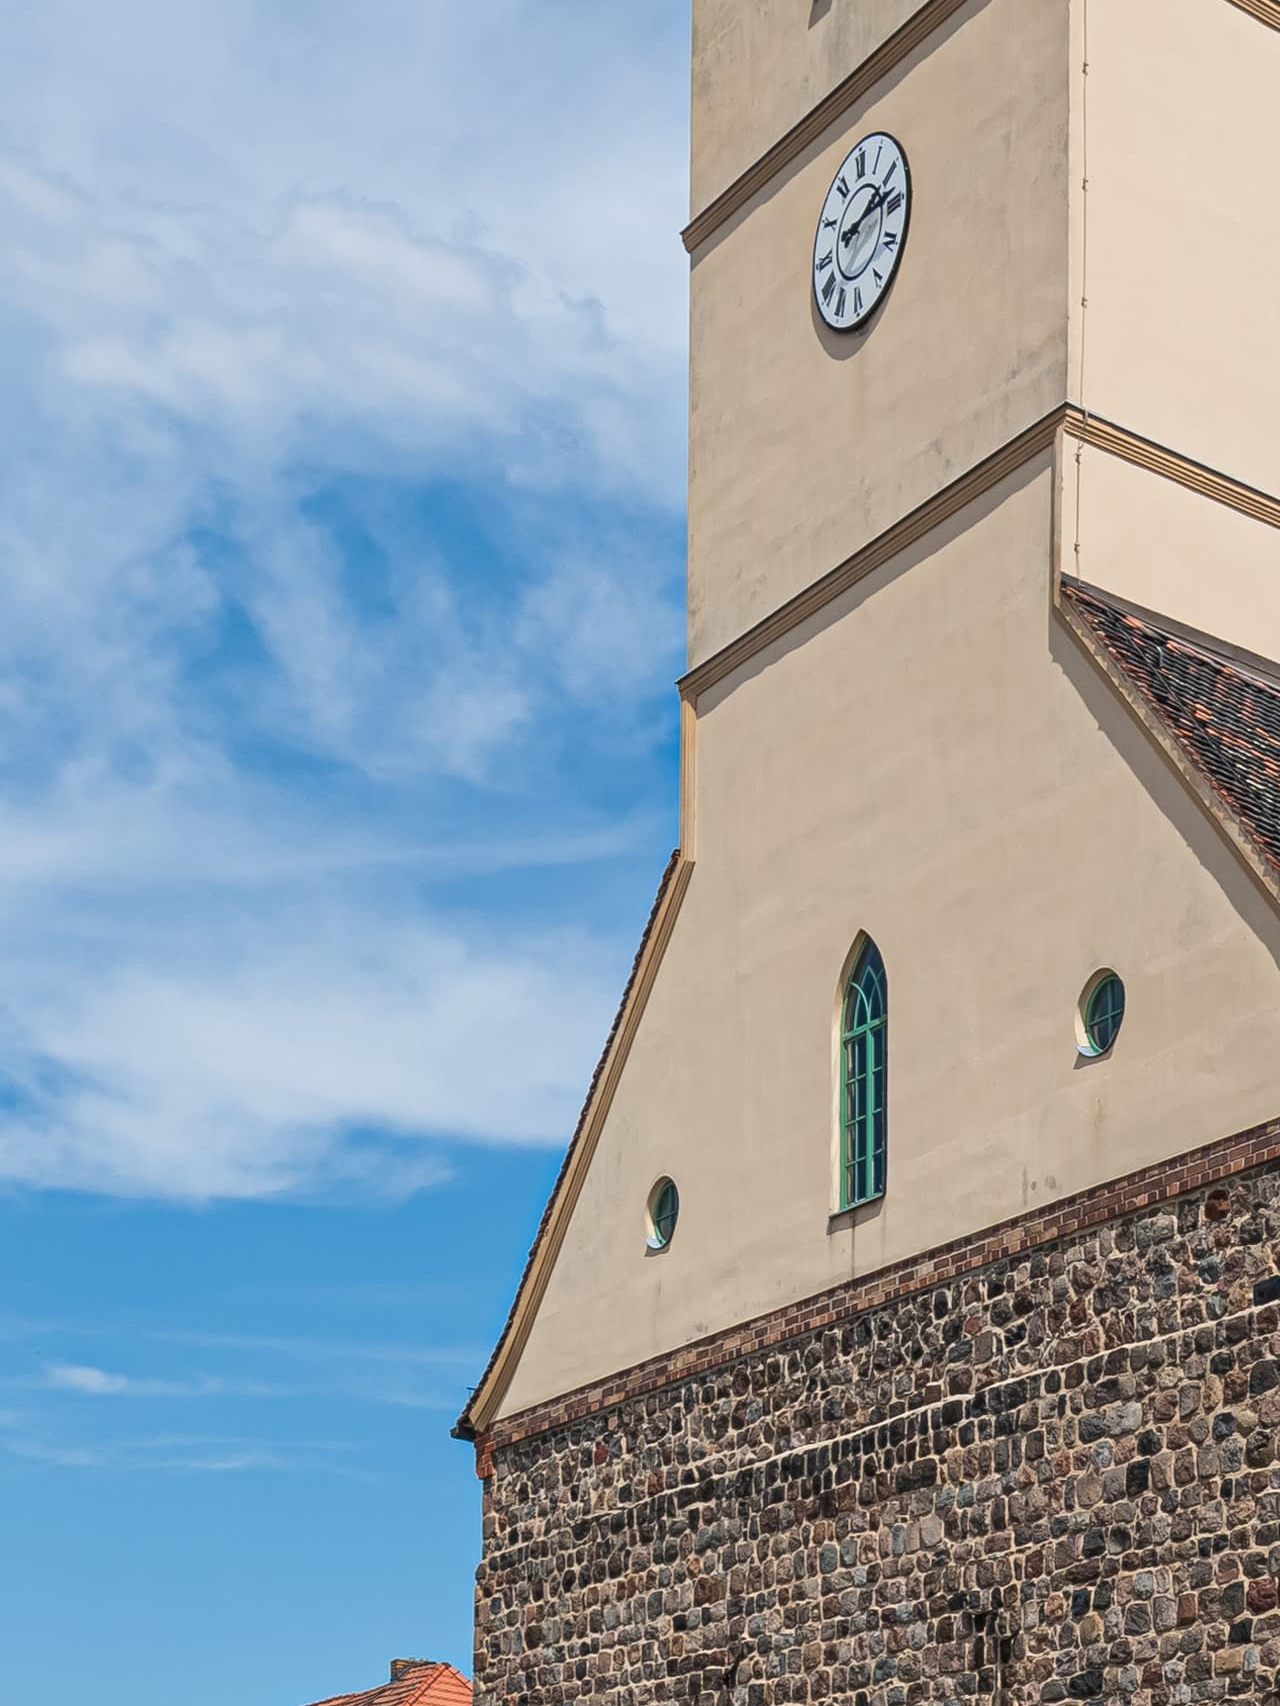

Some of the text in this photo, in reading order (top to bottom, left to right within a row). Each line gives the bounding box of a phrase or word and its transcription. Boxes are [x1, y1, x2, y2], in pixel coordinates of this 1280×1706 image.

[872, 146, 882, 174] I
[887, 191, 901, 215] III
[823, 218, 838, 232] X
[882, 232, 897, 252] IV
[872, 267, 883, 287] V
